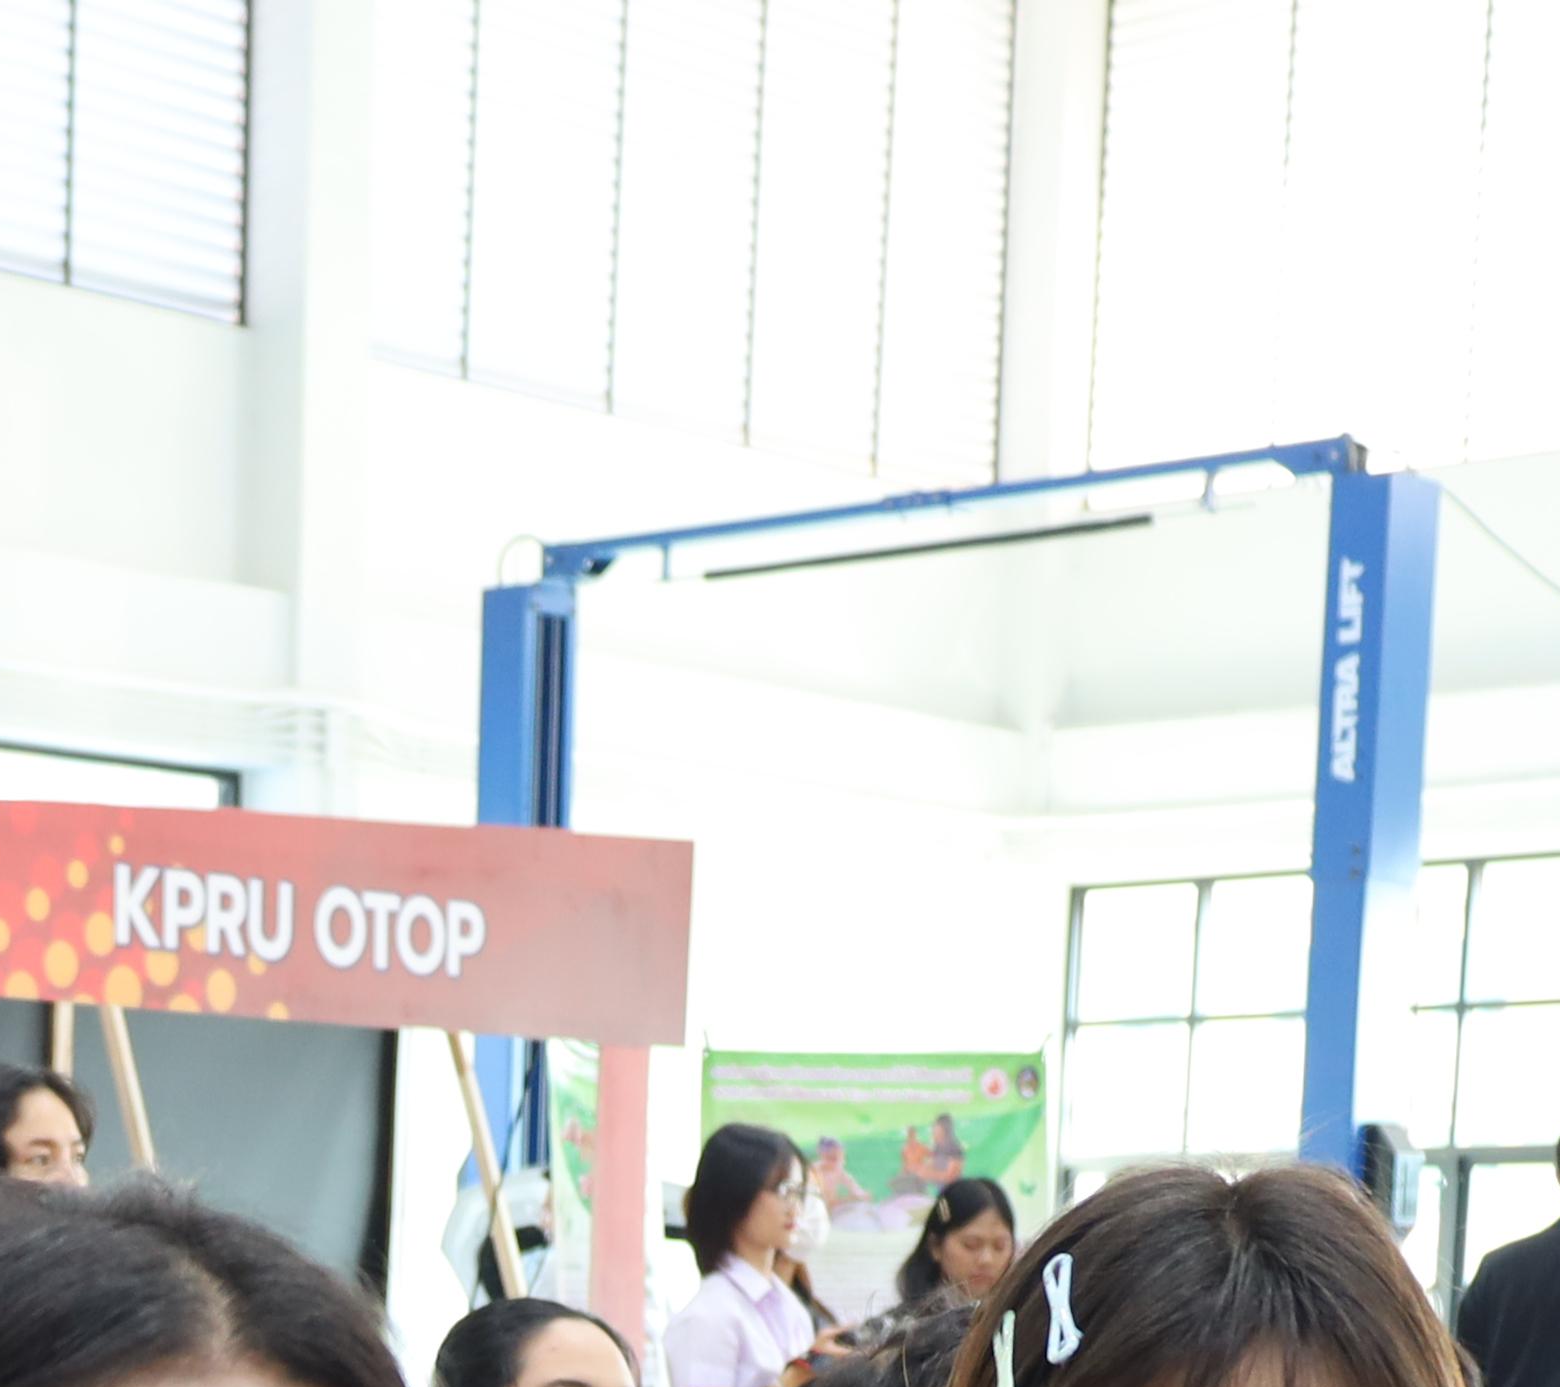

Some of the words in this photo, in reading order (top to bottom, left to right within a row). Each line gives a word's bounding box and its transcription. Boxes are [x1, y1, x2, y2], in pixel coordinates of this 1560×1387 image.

[1336, 556, 1365, 646] LIFT
[1331, 652, 1360, 783] ALTRA
[114, 862, 295, 962] KPRU
[314, 884, 486, 978] OTOP
